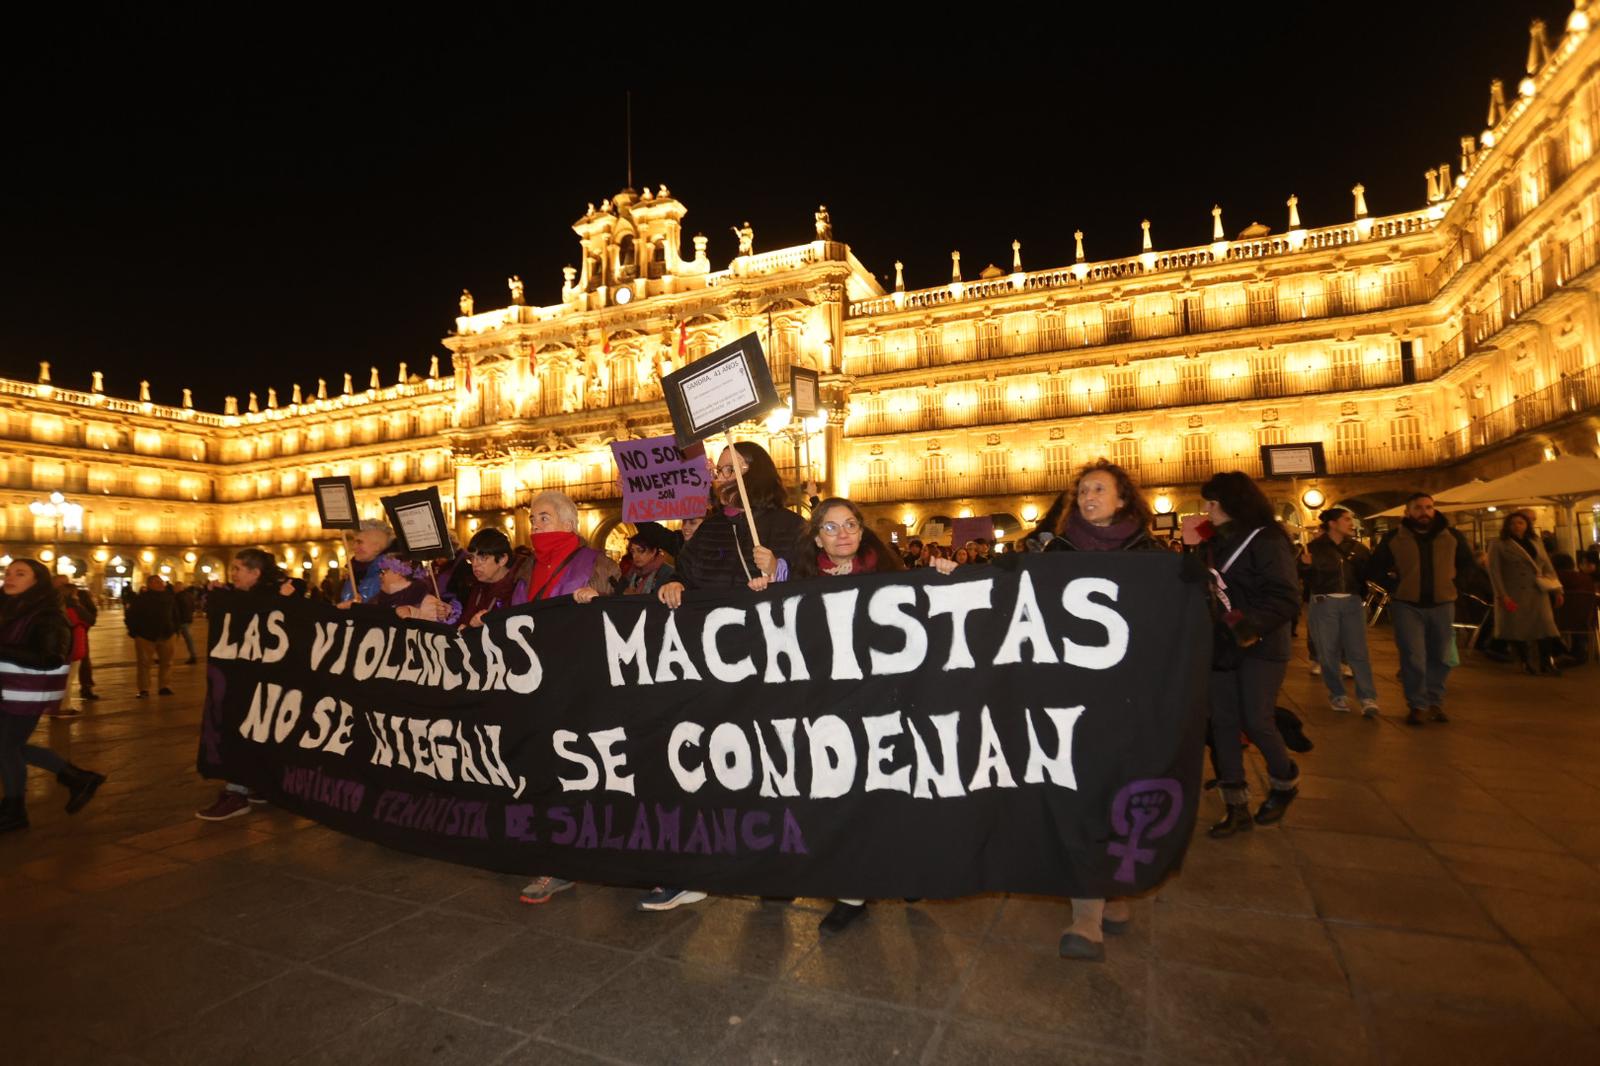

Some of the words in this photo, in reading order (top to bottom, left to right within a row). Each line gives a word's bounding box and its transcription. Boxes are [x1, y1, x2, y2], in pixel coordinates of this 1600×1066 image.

[620, 450, 648, 471] NO
[651, 446, 686, 464] SON
[628, 467, 707, 493] MUERTES,
[211, 611, 288, 662] LAS
[603, 570, 1129, 686] MACHISTAS
[240, 683, 301, 742] NO
[300, 697, 353, 755] SE
[366, 712, 526, 798] NIEGAN,
[553, 727, 635, 796] SE
[668, 705, 1085, 799] CONDENAN
[505, 803, 537, 842] DE
[547, 800, 810, 855] SALAMANCA
